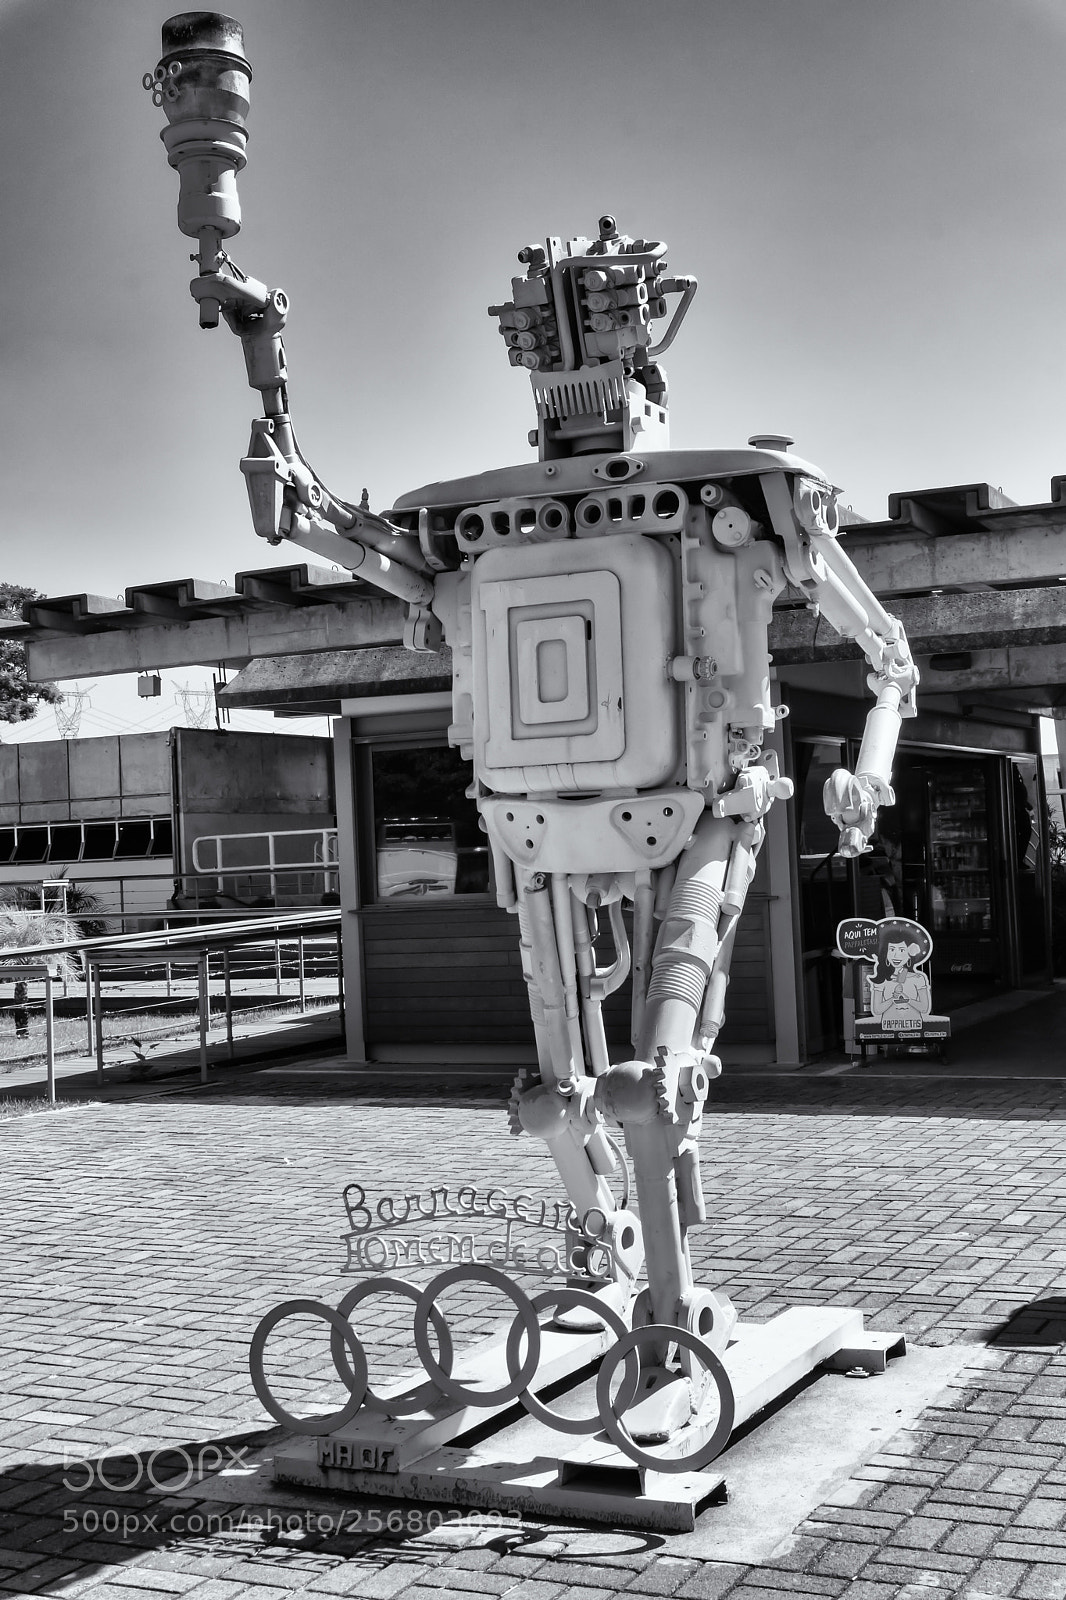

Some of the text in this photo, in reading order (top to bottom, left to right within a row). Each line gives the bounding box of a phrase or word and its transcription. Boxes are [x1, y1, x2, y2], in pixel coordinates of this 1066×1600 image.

[844, 927, 878, 940] AQUI TEM
[882, 1019, 921, 1029] PAPPALETAS
